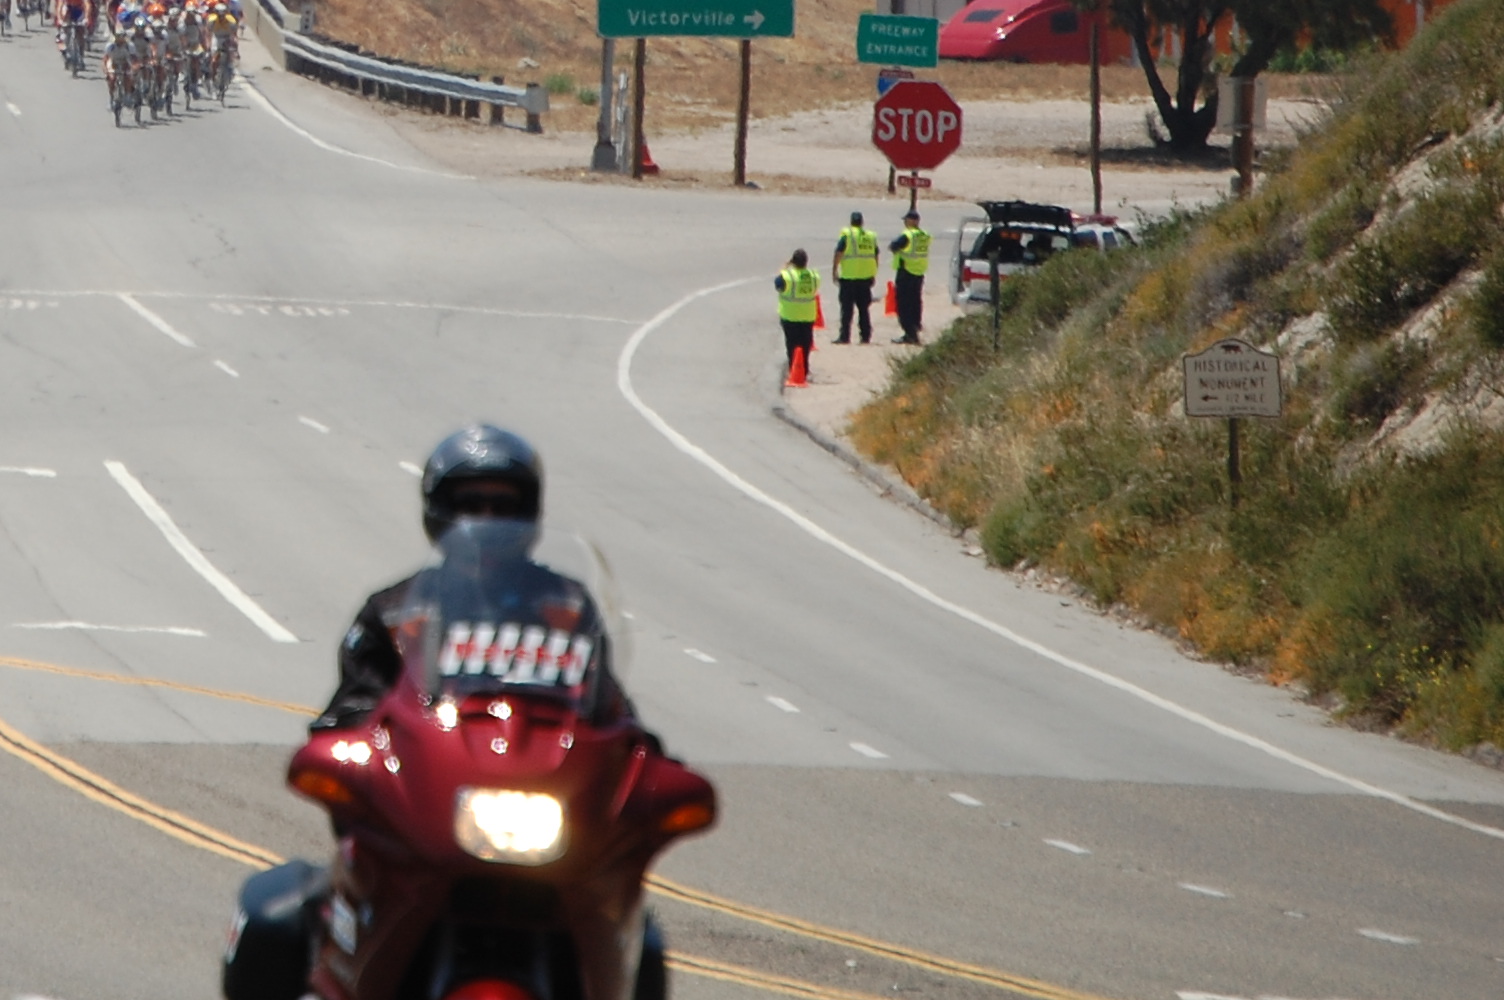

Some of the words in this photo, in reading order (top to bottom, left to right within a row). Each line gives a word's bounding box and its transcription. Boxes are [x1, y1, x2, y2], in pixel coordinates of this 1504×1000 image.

[627, 8, 736, 26] Victorville
[871, 22, 926, 37] FREEWAY
[866, 43, 929, 58] ENTRANCE
[877, 106, 958, 144] STOP
[1194, 359, 1268, 374] HISTORICAL
[1199, 376, 1265, 392] MONUMENT
[1243, 393, 1265, 404] MILE
